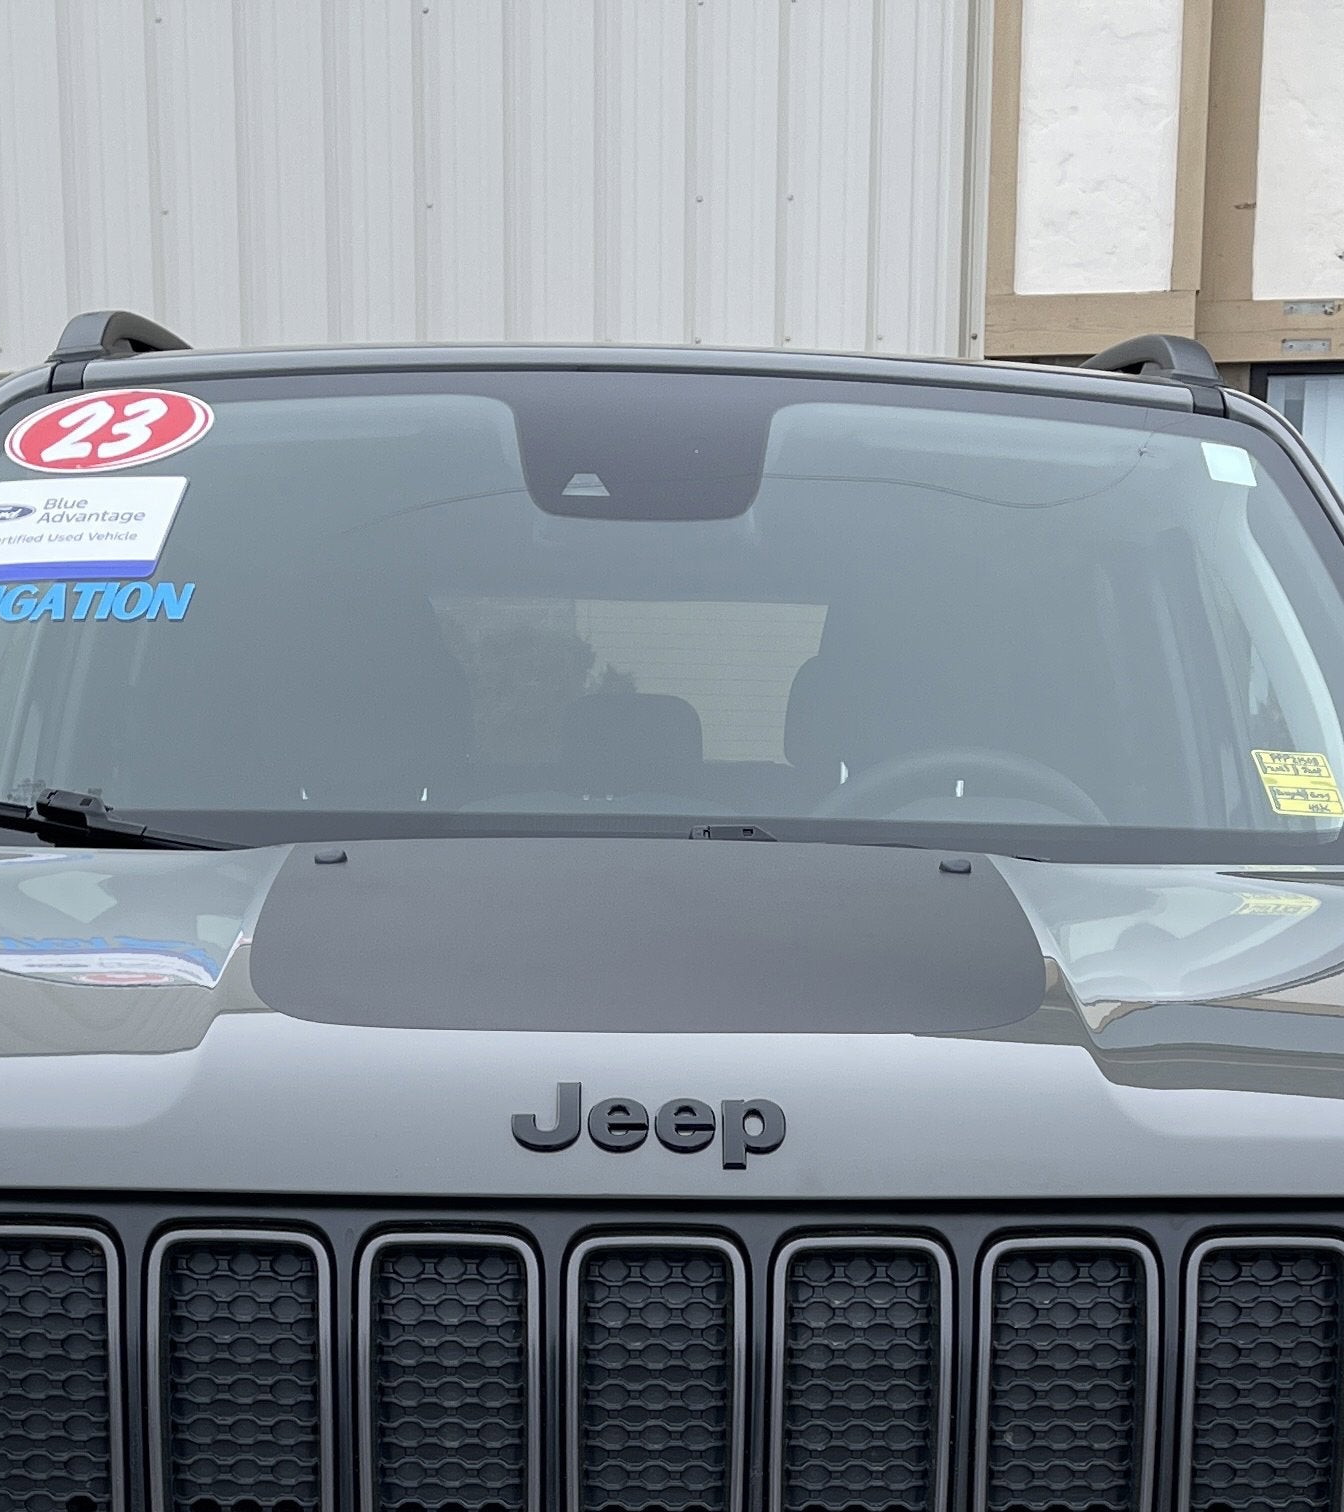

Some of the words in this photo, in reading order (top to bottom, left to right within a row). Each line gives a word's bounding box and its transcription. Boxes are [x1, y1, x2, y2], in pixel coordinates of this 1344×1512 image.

[40, 397, 168, 463] 23
[43, 498, 88, 511] Blue
[37, 510, 146, 524] Advantage
[47, 532, 84, 543] Used
[88, 530, 138, 542] Vehicle
[511, 1081, 786, 1170] Jeep
